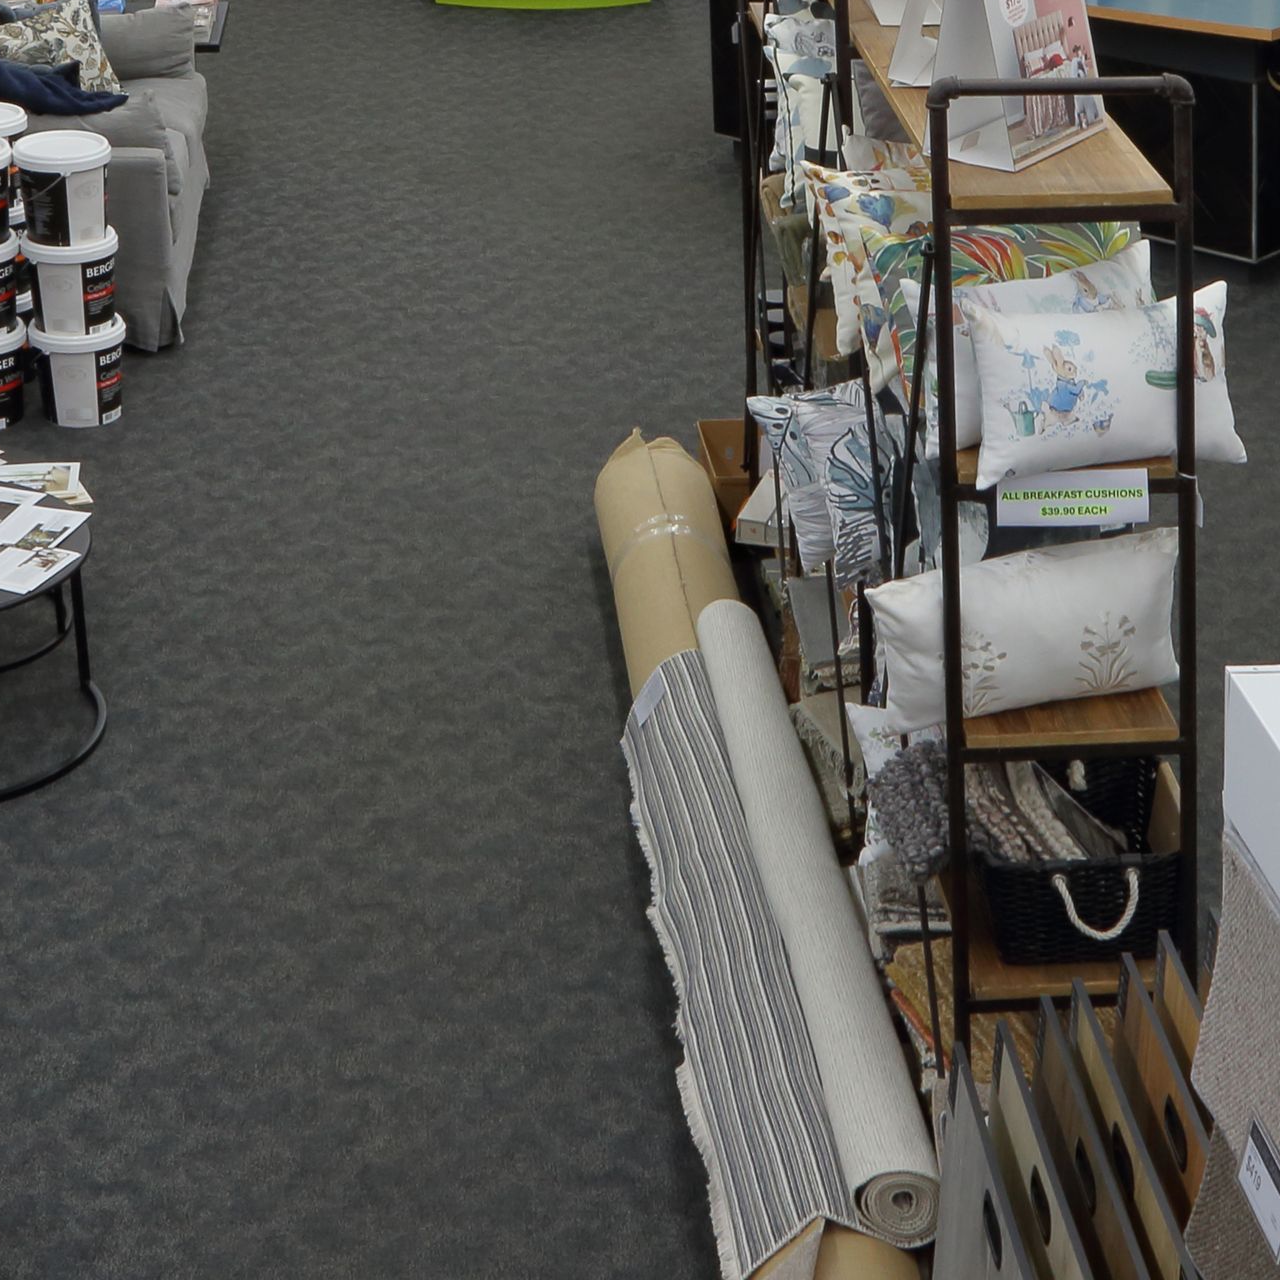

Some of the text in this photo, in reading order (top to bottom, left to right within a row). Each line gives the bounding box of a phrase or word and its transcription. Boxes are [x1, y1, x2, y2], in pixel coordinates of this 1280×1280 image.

[1001, 489, 1143, 500] ALL BREAKFAST CUSHIONS
[1041, 506, 1108, 516] $39.90 EACH
[1244, 1153, 1263, 1191] $419
